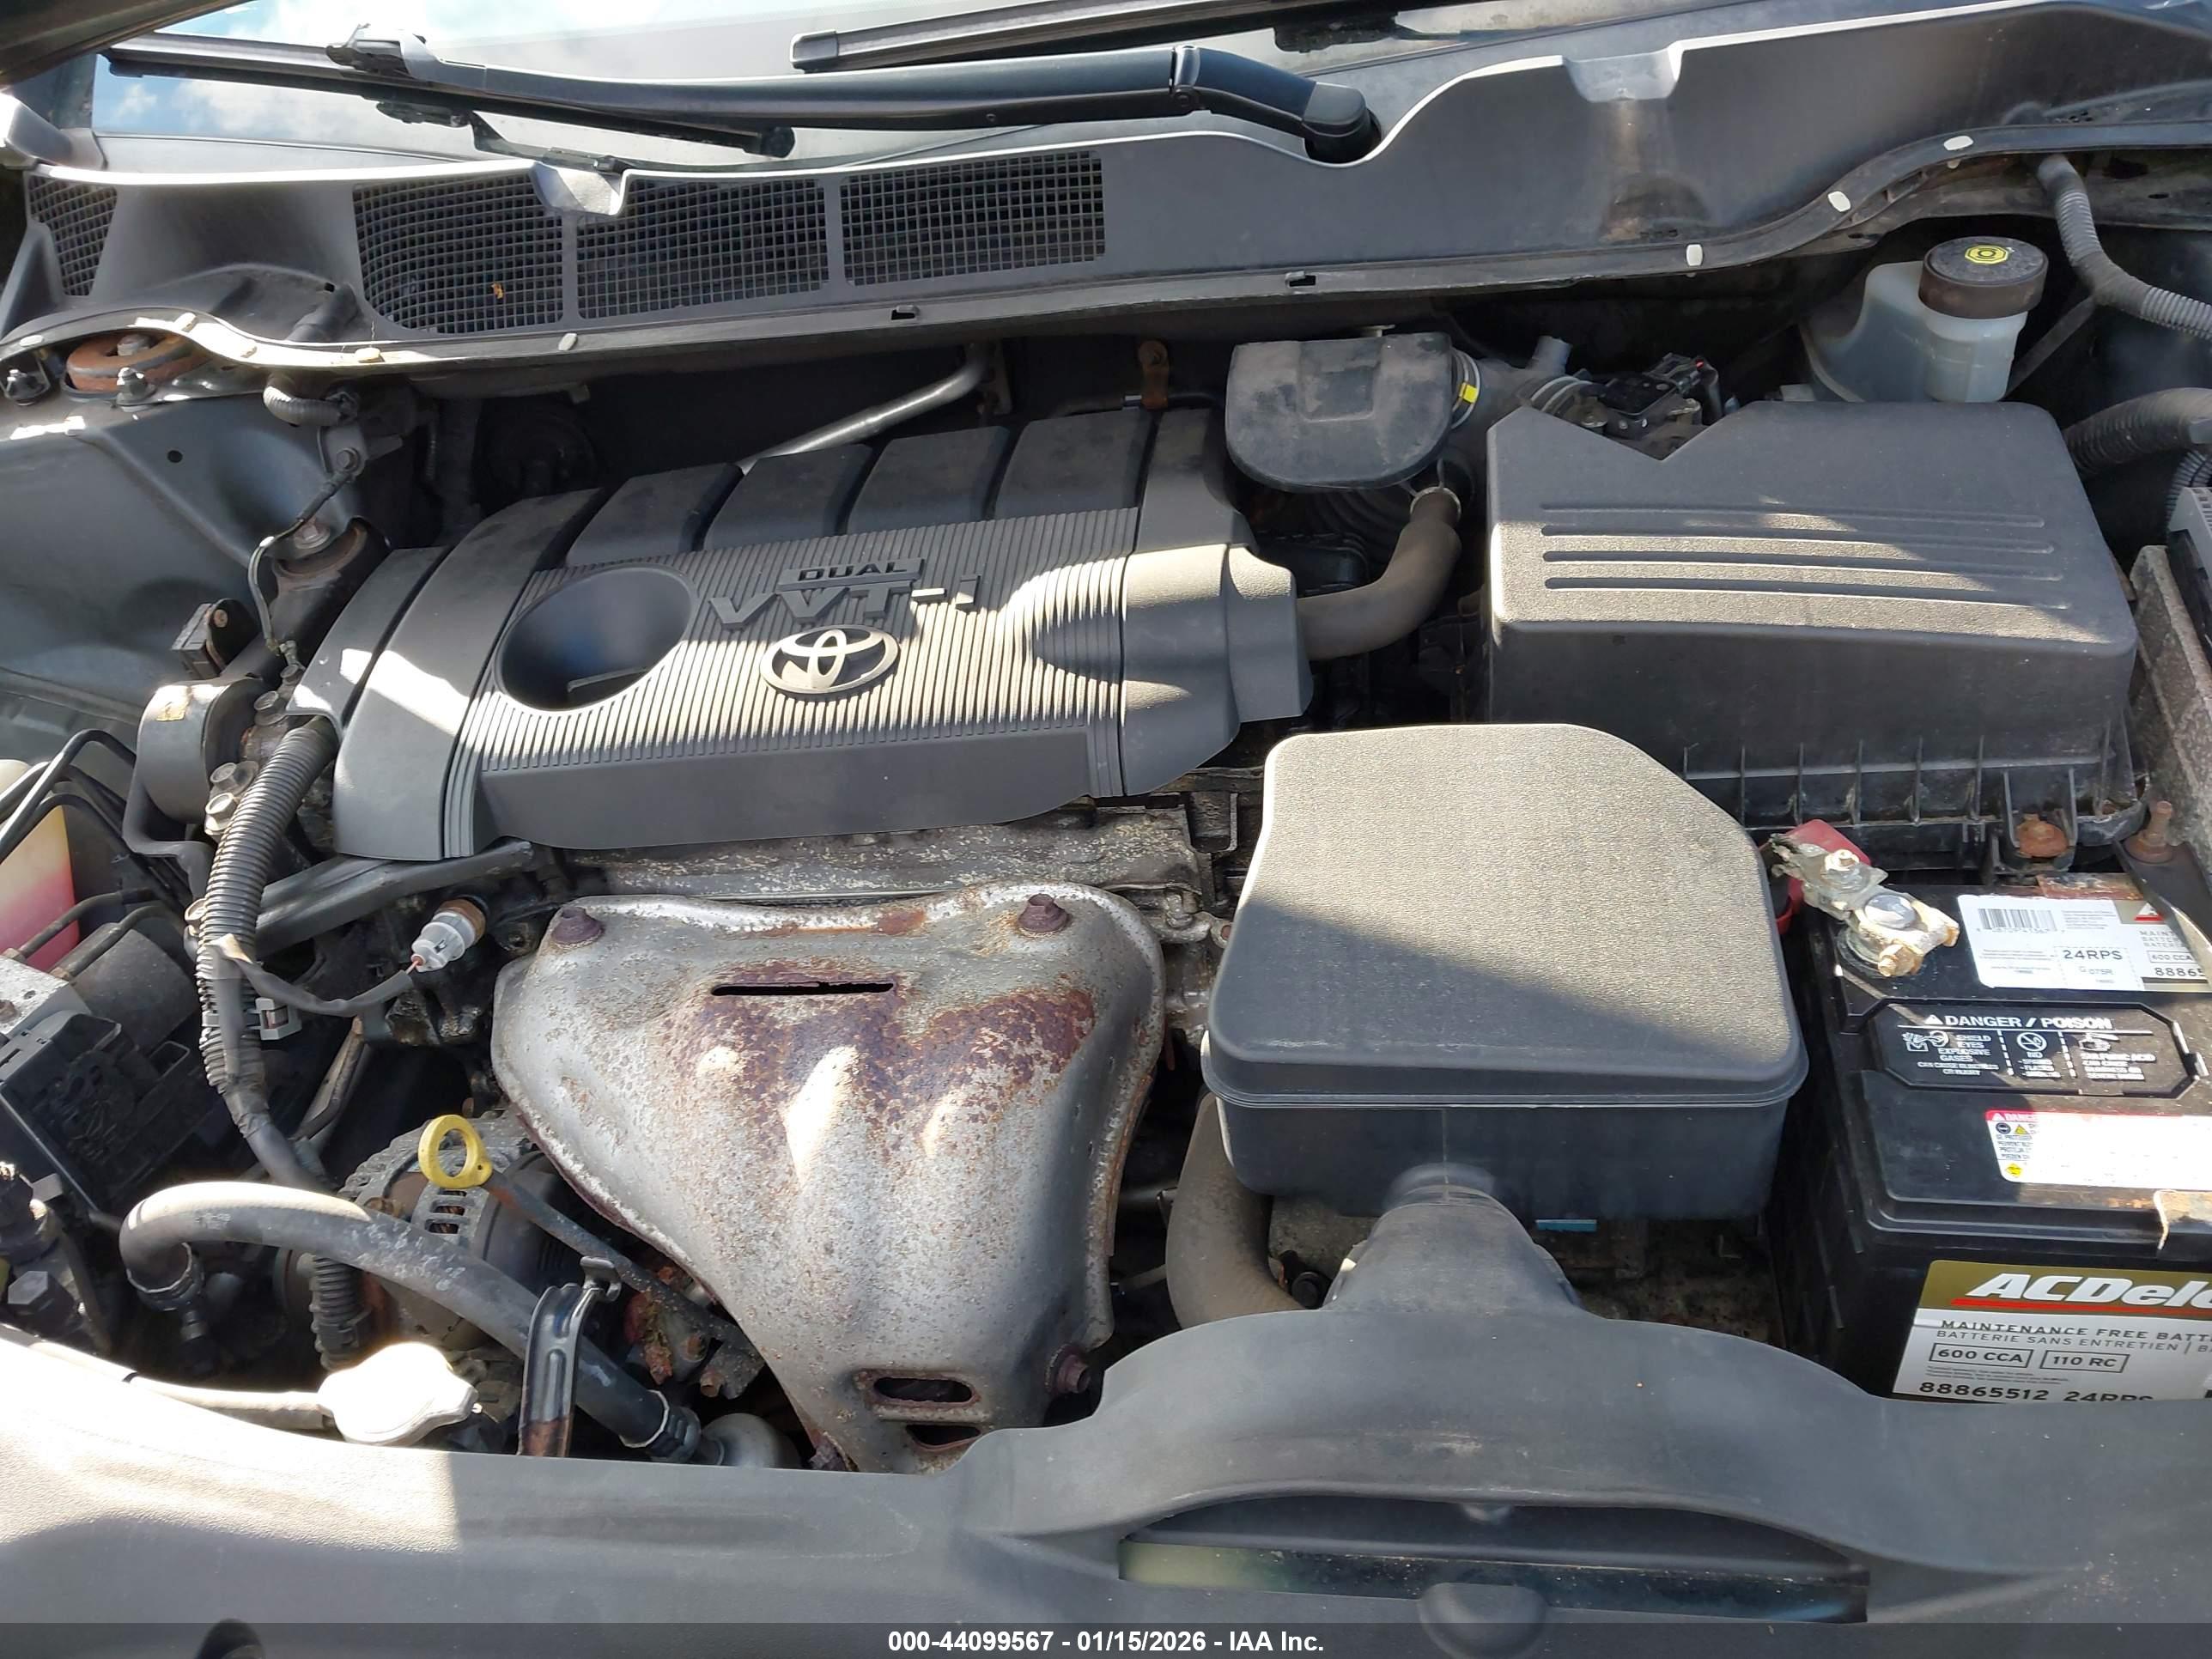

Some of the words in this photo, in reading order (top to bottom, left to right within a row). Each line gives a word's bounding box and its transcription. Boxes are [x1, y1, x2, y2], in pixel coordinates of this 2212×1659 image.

[798, 562, 908, 581] DUAL
[2063, 950, 2123, 960] 24RPS
[1944, 1016, 2022, 1027] DANGER
[2026, 1018, 2037, 1028] /
[2040, 1017, 2113, 1030] POISON
[1941, 1320, 2088, 1336] MAINTENANCE
[2096, 1328, 2152, 1339] FREE
[1936, 1330, 2020, 1343] BATTERIE
[2027, 1336, 2072, 1346] SANS
[2079, 1339, 2179, 1351] ENTRETIEN
[1938, 1349, 1978, 1359] 600
[1984, 1352, 2023, 1363] CCA
[2053, 1357, 2083, 1365] 110
[2089, 1358, 2118, 1367] RC
[1919, 1382, 2050, 1400] 88865512
